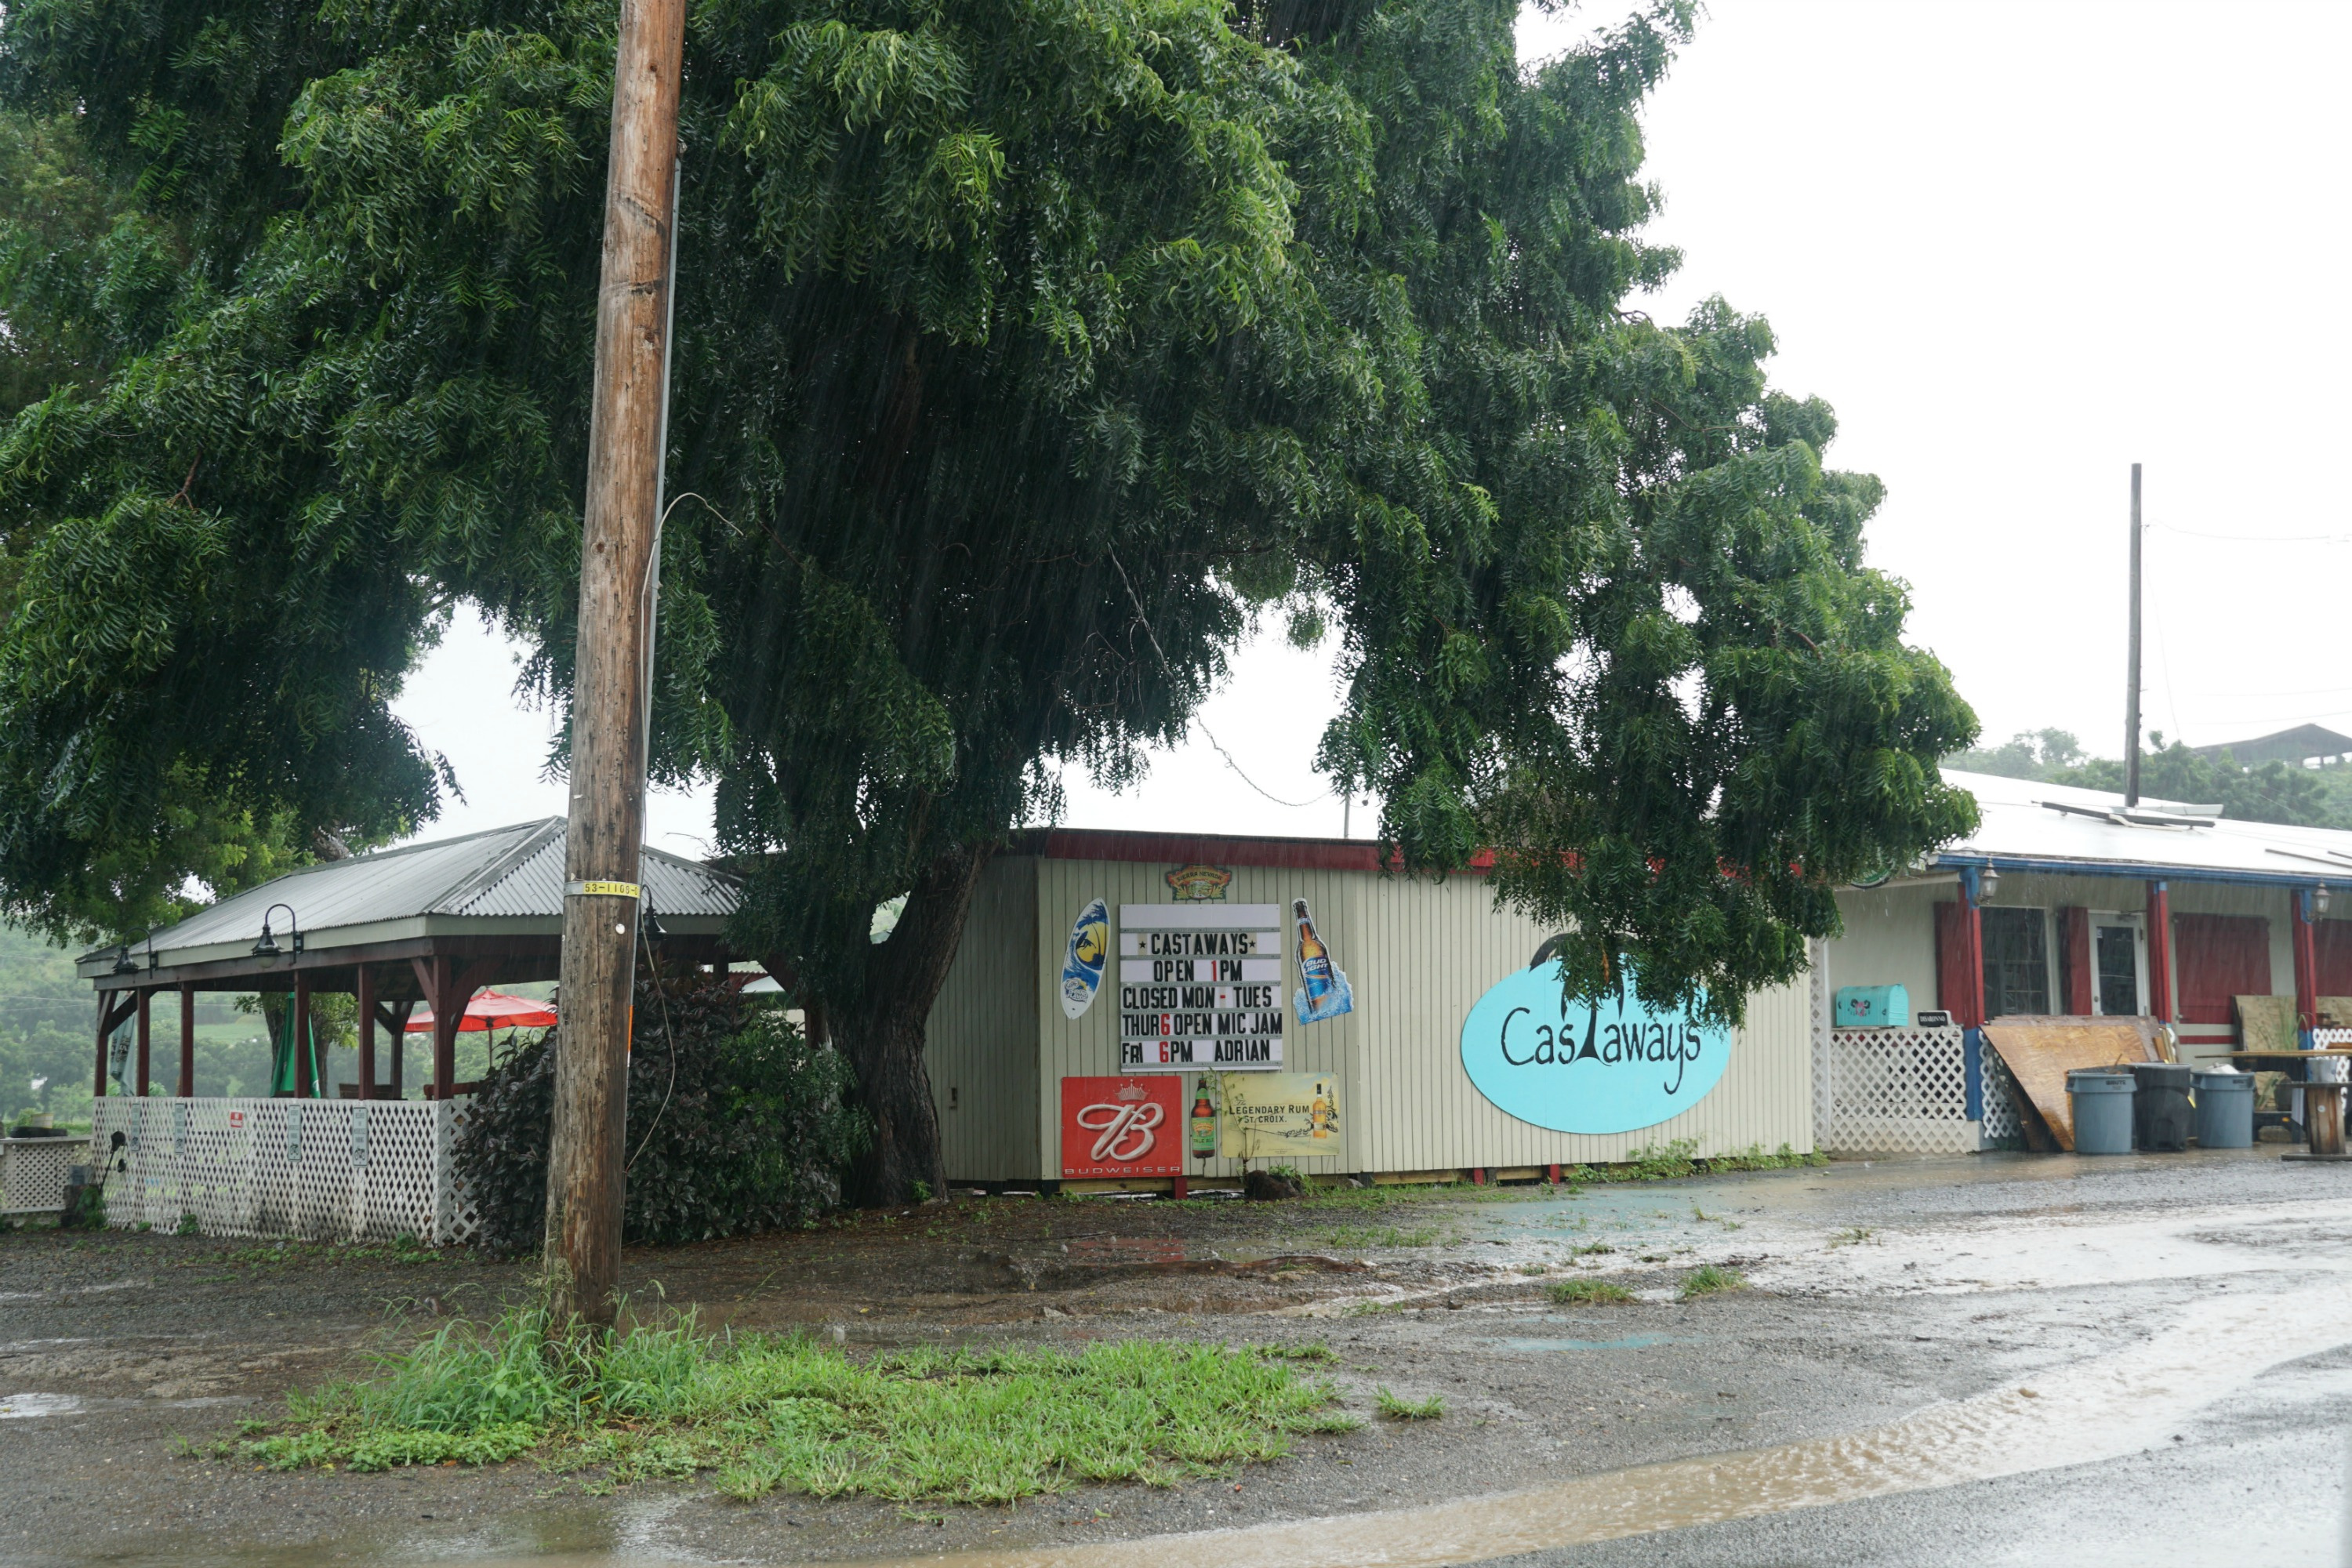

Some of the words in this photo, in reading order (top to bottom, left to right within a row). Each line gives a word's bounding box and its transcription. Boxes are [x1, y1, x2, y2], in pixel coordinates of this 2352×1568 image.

[1177, 872, 1198, 881] SIERRA
[1151, 933, 1248, 955] CASTAWAYS
[1153, 960, 1195, 982] OPEN
[1304, 964, 1328, 973] LIGHT
[1123, 987, 1178, 1009] CLOSED
[1181, 986, 1215, 1008] MON
[1233, 986, 1272, 1008] TUES
[1174, 1013, 1212, 1036] OPEN
[1218, 1013, 1246, 1035] MIC
[1250, 1013, 1283, 1034] JAM
[1122, 1043, 1143, 1063] FRI
[1159, 1040, 1193, 1062] 6PM
[1214, 1040, 1270, 1062] ADRIAN
[1229, 1105, 1285, 1115] LEGENDARY
[1289, 1105, 1309, 1113] RUM
